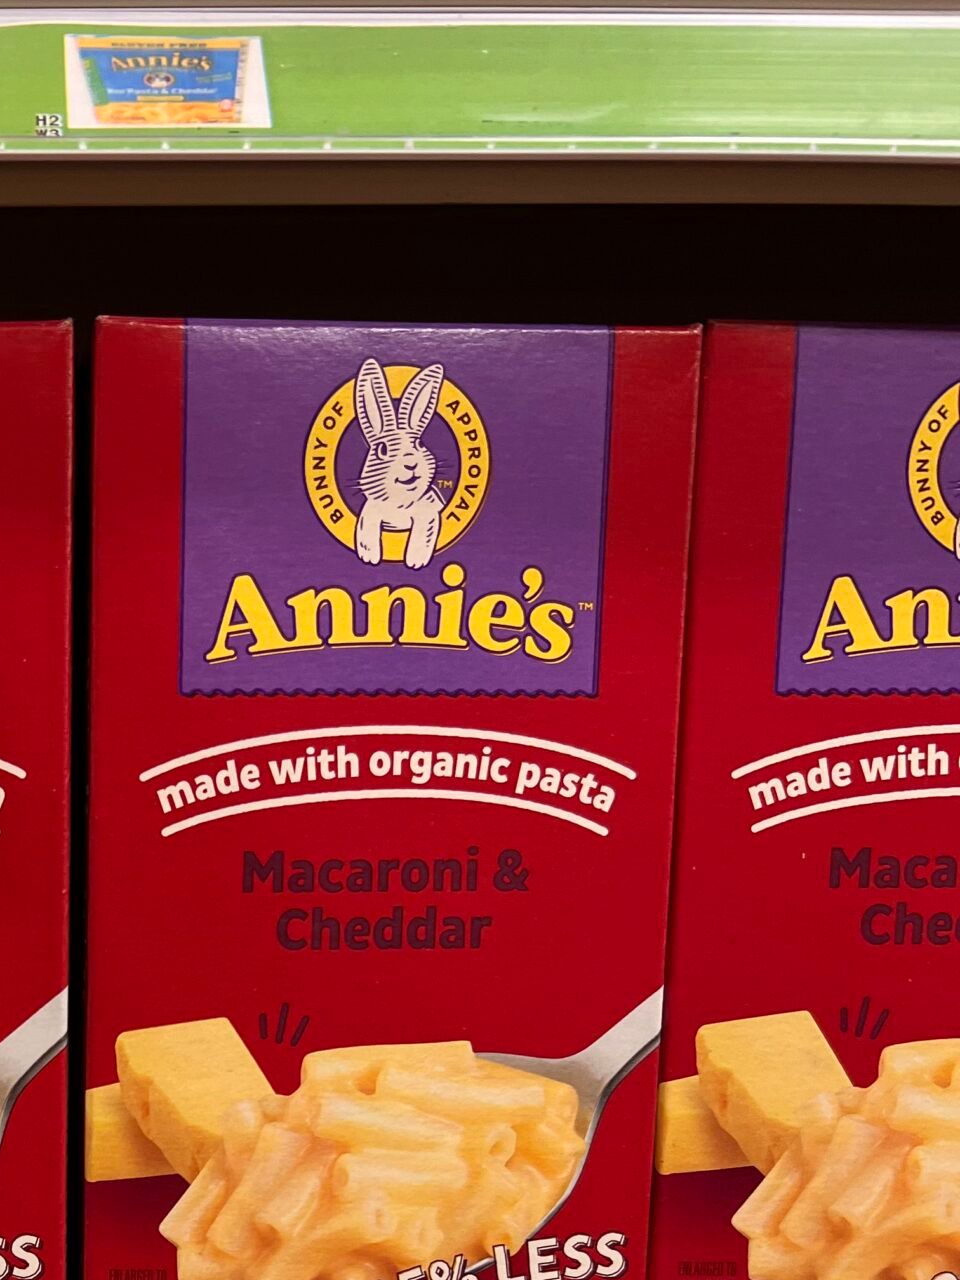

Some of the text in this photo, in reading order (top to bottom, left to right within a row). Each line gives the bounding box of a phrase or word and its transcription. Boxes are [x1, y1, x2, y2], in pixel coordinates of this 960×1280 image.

[35, 115, 60, 126] H2
[312, 399, 482, 525] BUNNY OF APPROVAL
[203, 563, 575, 664] Annie's
[156, 746, 616, 813] made with organic pasta
